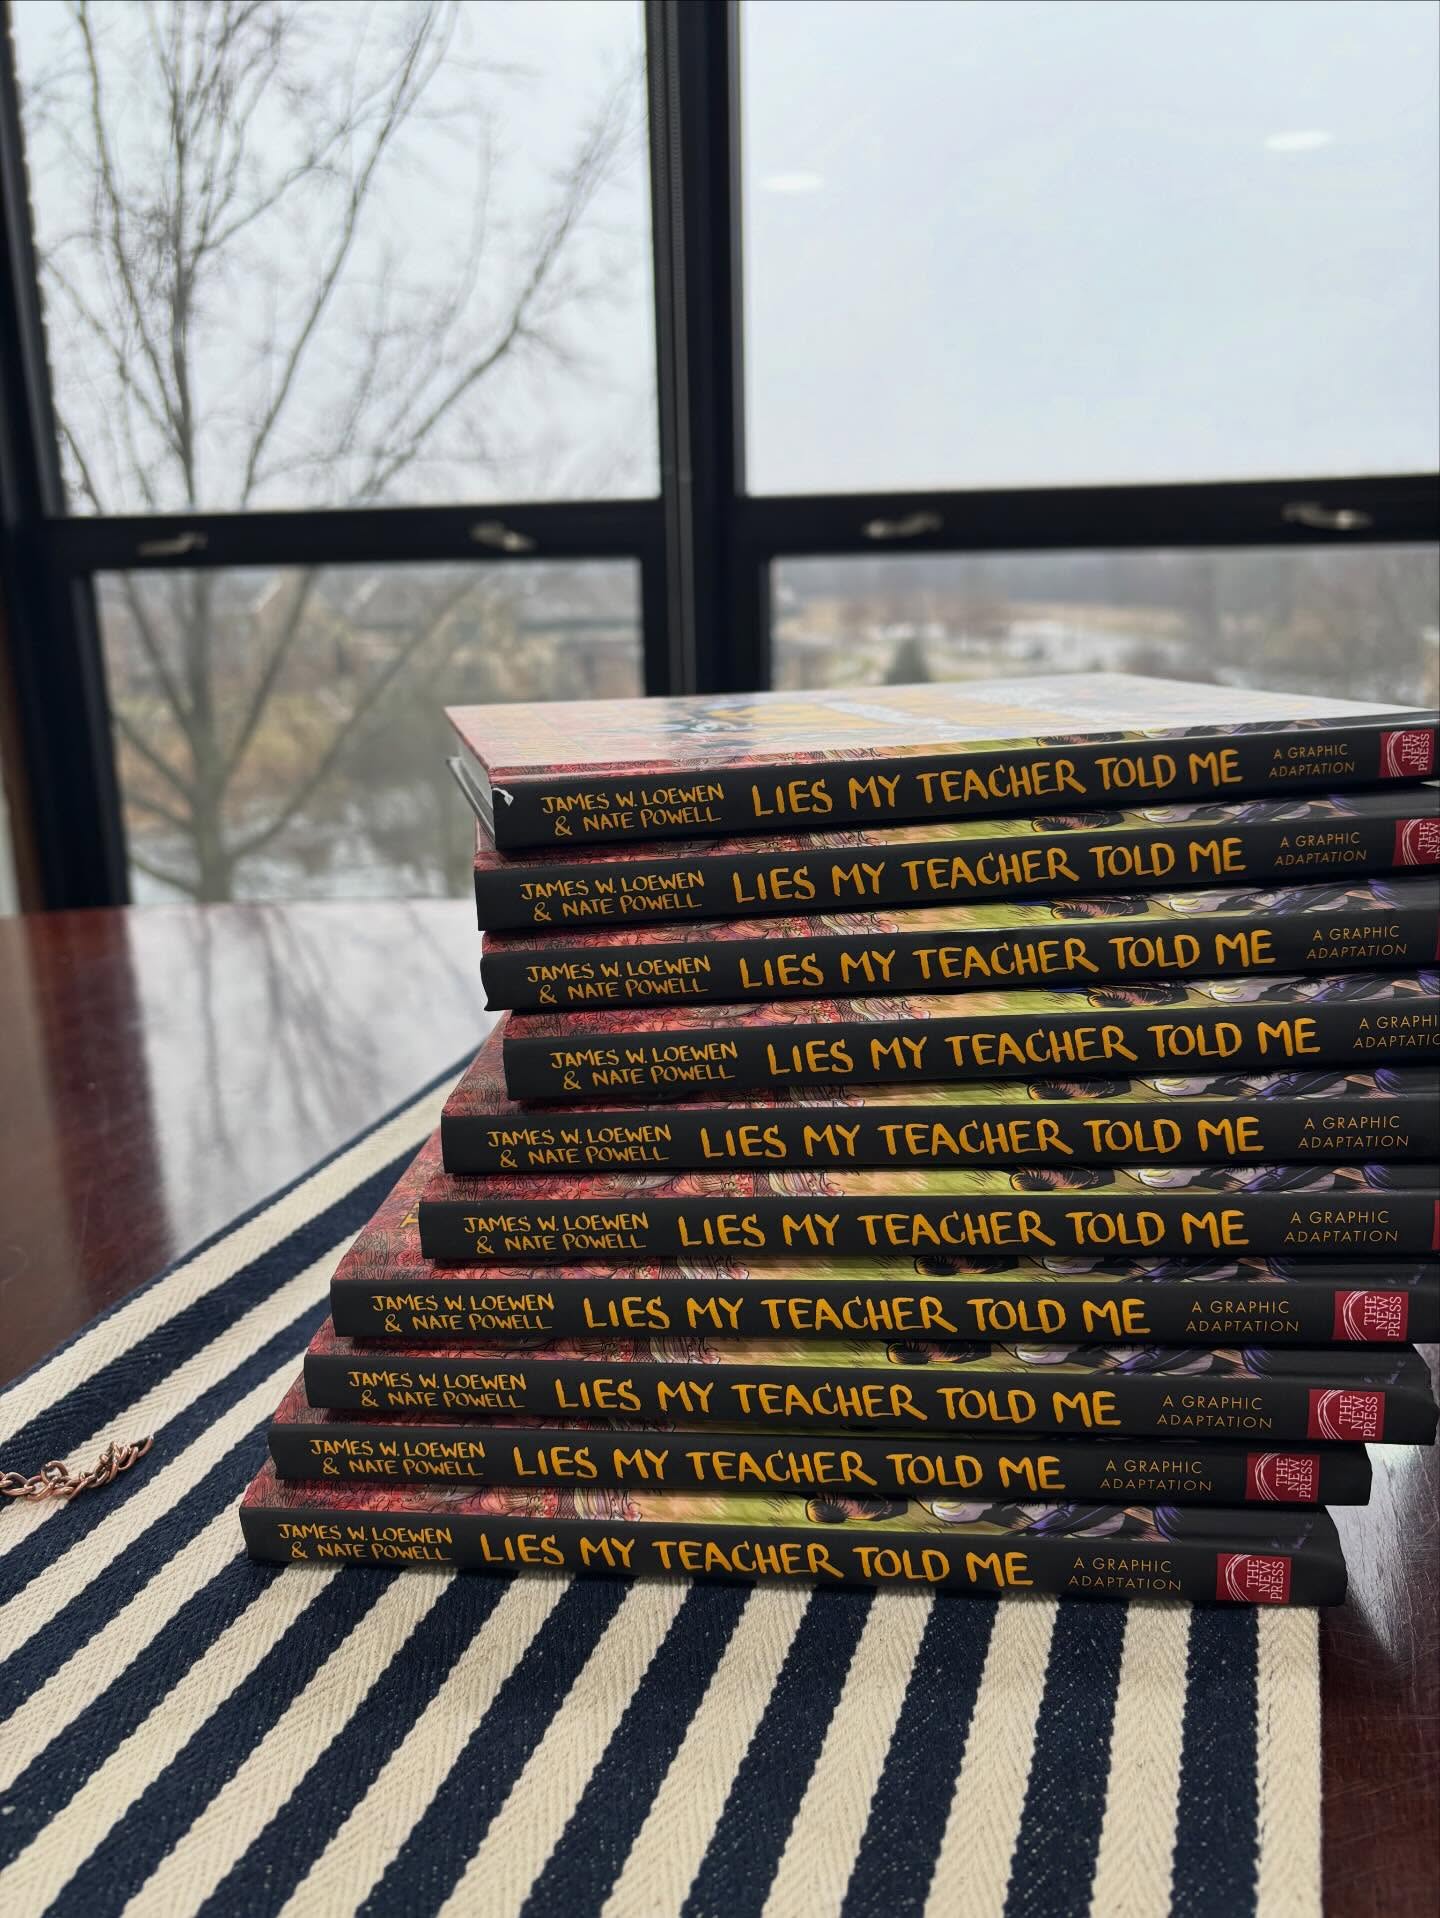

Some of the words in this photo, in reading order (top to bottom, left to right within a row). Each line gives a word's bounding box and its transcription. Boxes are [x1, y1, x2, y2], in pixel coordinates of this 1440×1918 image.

[1273, 749, 1282, 759] A
[1287, 744, 1348, 759] GRAPHIC
[1401, 734, 1412, 762] THE
[1409, 734, 1420, 765] NEW
[1418, 733, 1430, 771] PRESS
[752, 779, 833, 816] LIES
[848, 774, 900, 810] MY
[916, 759, 1087, 803] TEACHER
[1094, 754, 1176, 790] TOLD
[1188, 749, 1242, 786] ME
[1269, 761, 1355, 778] ADAPTATION
[541, 793, 609, 813] JAMES
[615, 791, 637, 807] W.
[641, 783, 724, 806] LOEWEN
[555, 815, 573, 836] &
[583, 812, 634, 831] NATE
[640, 806, 721, 828] POWELL
[1280, 836, 1289, 848] A
[1295, 832, 1360, 847] GRAPHIC
[1418, 822, 1430, 850] THE
[733, 866, 815, 903] LIES
[831, 862, 885, 896] MY
[901, 847, 1080, 891] TEACHER
[1088, 842, 1175, 878] TOLD
[1188, 837, 1246, 874] ME
[1274, 850, 1367, 866] ADAPTATION
[520, 880, 589, 900] JAMES
[595, 878, 617, 894] W.
[621, 870, 704, 892] LOEWEN
[534, 902, 552, 921] &
[562, 898, 614, 917] NATE
[620, 893, 702, 914] POWELL
[1313, 929, 1322, 941] A
[1329, 925, 1399, 940] GRAPHIC
[739, 953, 824, 988] LIES
[840, 950, 895, 983] MY
[912, 938, 1099, 979] TEACHER
[1108, 934, 1200, 969] TOLD
[1215, 929, 1275, 967] ME
[1306, 943, 1407, 959] ADAPTATION
[526, 963, 594, 982] JAMES
[600, 961, 622, 977] W.
[626, 955, 711, 976] LOEWEN
[539, 984, 557, 1004] &
[567, 982, 619, 1000] NATE
[625, 978, 708, 997] POWELL
[1359, 1018, 1369, 1029] A
[1376, 1014, 1438, 1029] GRAPHI
[549, 1049, 619, 1068] JAMES
[625, 1048, 647, 1064] W.
[652, 1041, 738, 1063] LOEWEN
[767, 1039, 854, 1075] LIES
[870, 1036, 927, 1070] MY
[944, 1025, 1138, 1066] TEACHER
[1147, 1022, 1243, 1057] TOLD
[1257, 1017, 1320, 1056] ME
[563, 1071, 582, 1090] &
[592, 1068, 644, 1086] NATE
[650, 1064, 735, 1084] POWELL
[1304, 1118, 1315, 1129] A
[1322, 1115, 1400, 1129] GRAPHIC
[487, 1129, 555, 1147] JAMES
[560, 1128, 582, 1144] W.
[587, 1124, 671, 1143] LOEWEN
[700, 1125, 787, 1158] LIES
[803, 1124, 860, 1157] MY
[877, 1119, 1073, 1156] TEACHER
[1083, 1119, 1182, 1153] TOLD
[1197, 1116, 1264, 1154] ME
[1298, 1135, 1409, 1148] ADAPTATION
[500, 1149, 518, 1168] &
[528, 1148, 580, 1165] NATE
[585, 1146, 669, 1164] POWELL
[464, 1215, 531, 1233] JAMES
[537, 1216, 559, 1231] W.
[563, 1212, 649, 1231] LOEWEN
[678, 1214, 766, 1247] LIES
[782, 1214, 840, 1246] MY
[857, 1210, 1056, 1246] TEACHER
[1065, 1211, 1165, 1246] TOLD
[1181, 1210, 1249, 1248] ME
[1290, 1212, 1301, 1224] A
[1309, 1210, 1389, 1224] GRAPHIC
[476, 1236, 494, 1254] &
[504, 1235, 556, 1251] NATE
[562, 1233, 646, 1251] POWELL
[1284, 1230, 1398, 1242] ADAPTATION
[371, 1294, 438, 1311] JAMES
[444, 1295, 466, 1311] W.
[470, 1293, 554, 1311] LOEWEN
[1192, 1301, 1202, 1313] A
[1210, 1300, 1289, 1314] GRAPHIC
[1363, 1295, 1378, 1326] THE
[1376, 1296, 1389, 1330] NEW
[385, 1313, 402, 1332] &
[412, 1315, 463, 1330] NATE
[468, 1313, 552, 1330] POWELL
[583, 1296, 670, 1329] LIES
[686, 1297, 743, 1329] MY
[760, 1296, 958, 1332] TEACHER
[966, 1298, 1066, 1333] TOLD
[1082, 1298, 1151, 1336] ME
[1185, 1320, 1299, 1332] ADAPTATION
[1387, 1296, 1402, 1337] PRESS
[348, 1371, 413, 1388] JAMES
[419, 1373, 439, 1388] W.
[444, 1373, 526, 1390] LOEWEN
[361, 1389, 379, 1407] &
[387, 1391, 438, 1407] NATE
[443, 1391, 524, 1408] POWELL
[555, 1378, 641, 1411] LIES
[657, 1381, 714, 1413] MY
[731, 1383, 928, 1420] TEACHER
[936, 1387, 1036, 1424] TOLD
[1052, 1391, 1121, 1427] ME
[1163, 1395, 1174, 1407] A
[1181, 1395, 1262, 1410] GRAPHIC
[1338, 1395, 1353, 1424] THE
[1156, 1414, 1272, 1429] ADAPTATION
[1351, 1395, 1364, 1430] NEW
[1362, 1396, 1378, 1437] PRESS
[310, 1439, 373, 1456] JAMES
[379, 1441, 400, 1456] W.
[404, 1441, 485, 1458] LOEWEN
[323, 1457, 340, 1475] &
[349, 1459, 398, 1474] NATE
[403, 1459, 483, 1476] POWELL
[513, 1446, 598, 1478] LIES
[613, 1448, 669, 1480] MY
[685, 1450, 877, 1486] TEACHER
[885, 1453, 983, 1488] TOLD
[998, 1455, 1065, 1491] ME
[1106, 1459, 1116, 1471] A
[1124, 1459, 1202, 1474] GRAPHIC
[1276, 1458, 1289, 1487] THE
[1287, 1458, 1300, 1491] NEW
[1298, 1459, 1313, 1498] PRESS
[1100, 1478, 1211, 1491] ADAPTATION
[278, 1523, 342, 1540] JAMES
[347, 1526, 368, 1541] W.
[372, 1527, 452, 1544] LOEWEN
[291, 1541, 308, 1559] &
[317, 1543, 365, 1558] NATE
[371, 1543, 450, 1560] POWELL
[480, 1533, 564, 1565] LIES
[579, 1537, 635, 1567] MY
[652, 1541, 844, 1578] TEACHER
[852, 1547, 950, 1582] TOLD
[966, 1552, 1034, 1587] ME
[1074, 1557, 1085, 1569] A
[1092, 1557, 1171, 1573] GRAPHIC
[1246, 1559, 1260, 1588] THE
[1258, 1560, 1271, 1593] NEW
[1068, 1575, 1181, 1591] ADAPTATION
[1269, 1561, 1284, 1600] PRESS
